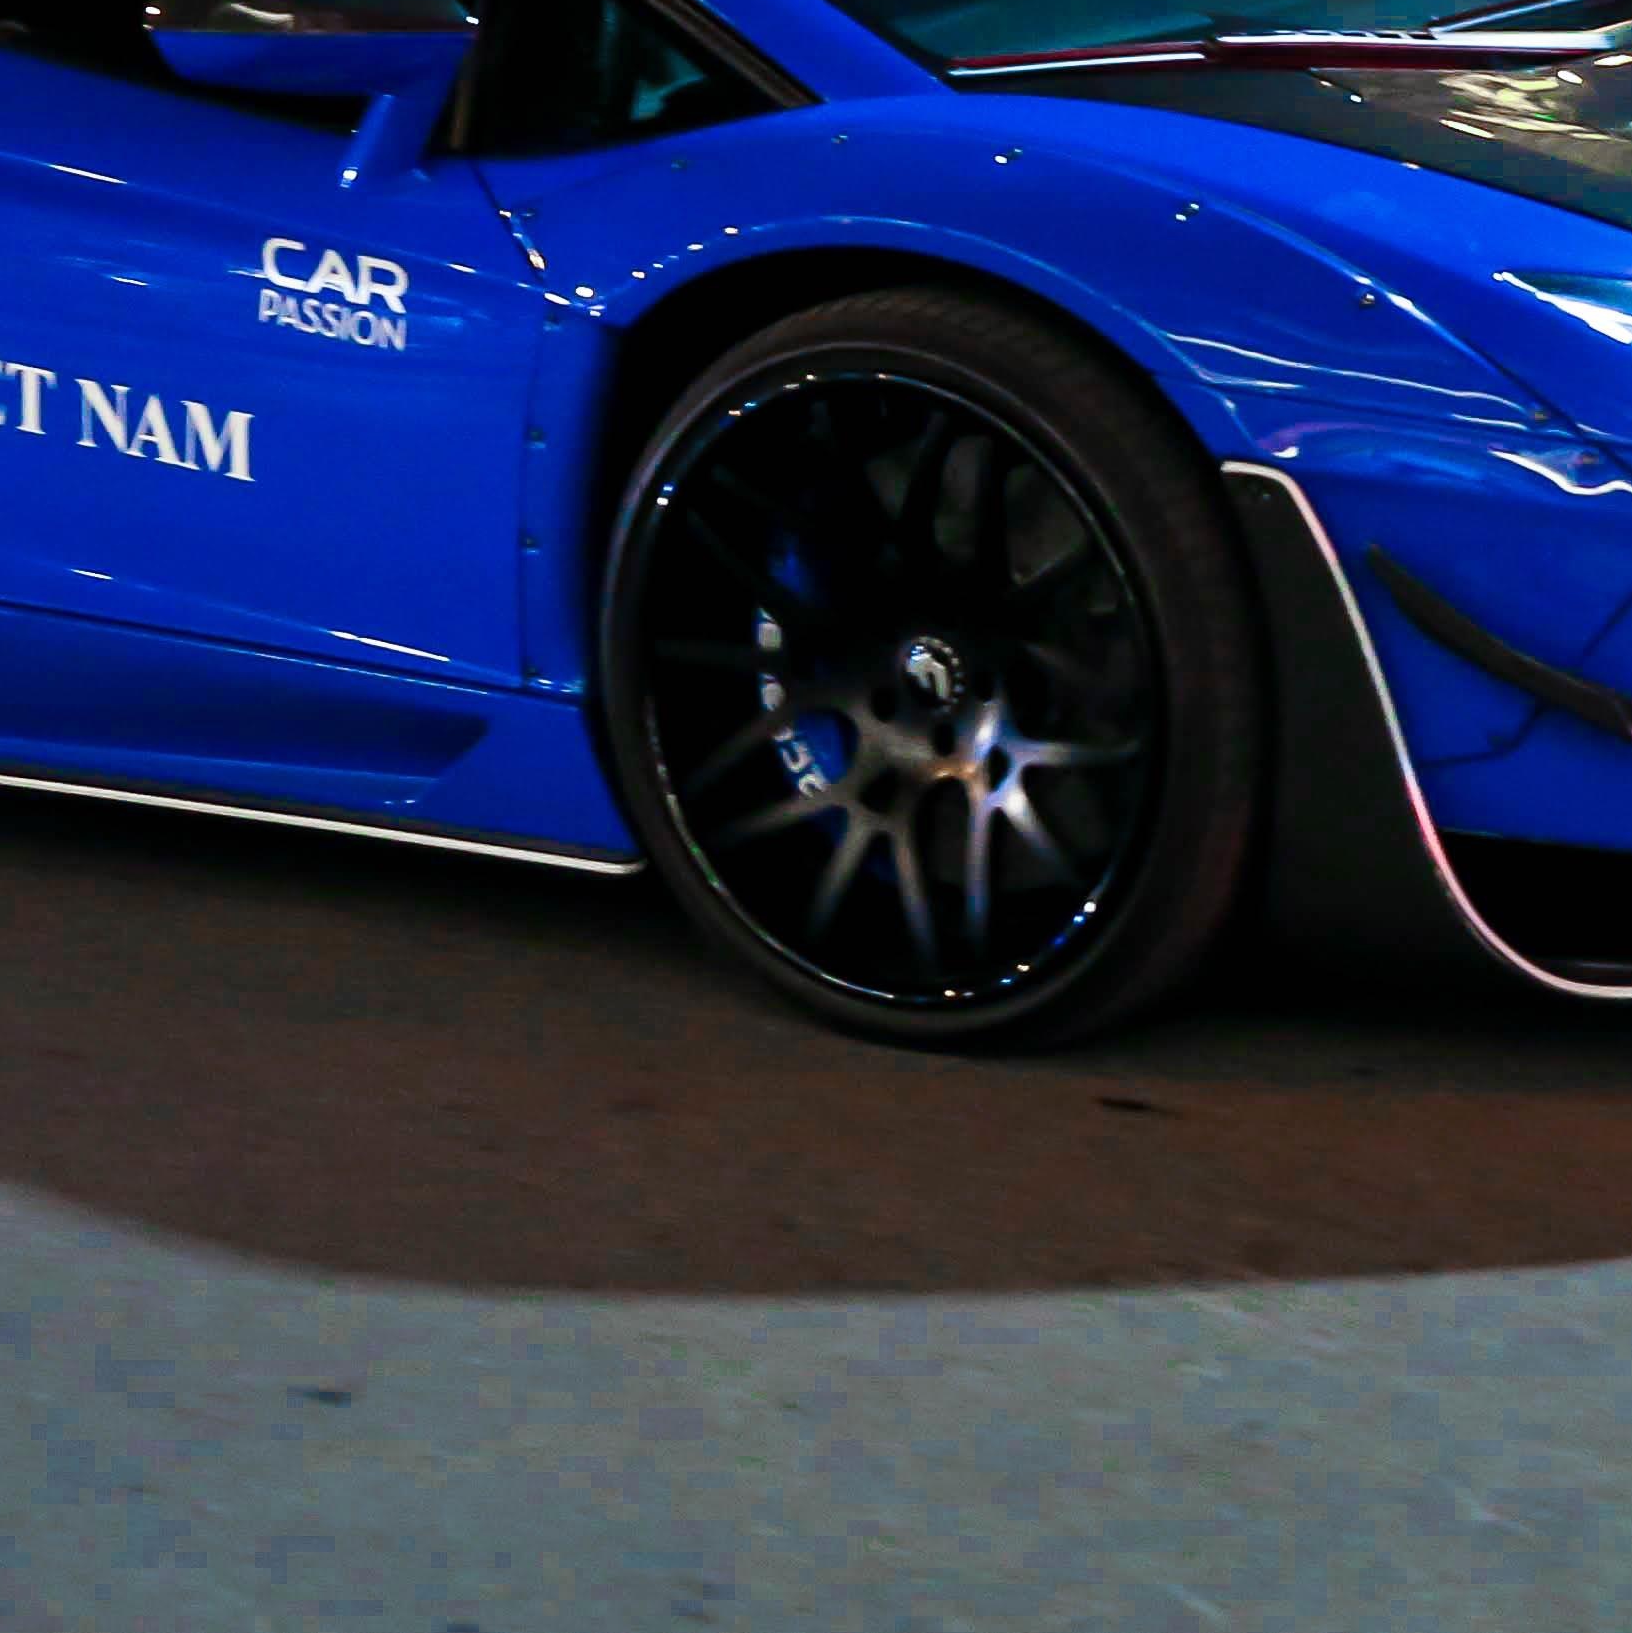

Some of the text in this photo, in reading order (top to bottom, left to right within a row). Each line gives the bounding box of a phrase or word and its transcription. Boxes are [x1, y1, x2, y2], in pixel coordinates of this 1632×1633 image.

[262, 237, 409, 315] CAR
[258, 287, 408, 352] PASSION
[75, 377, 257, 483] NAM
